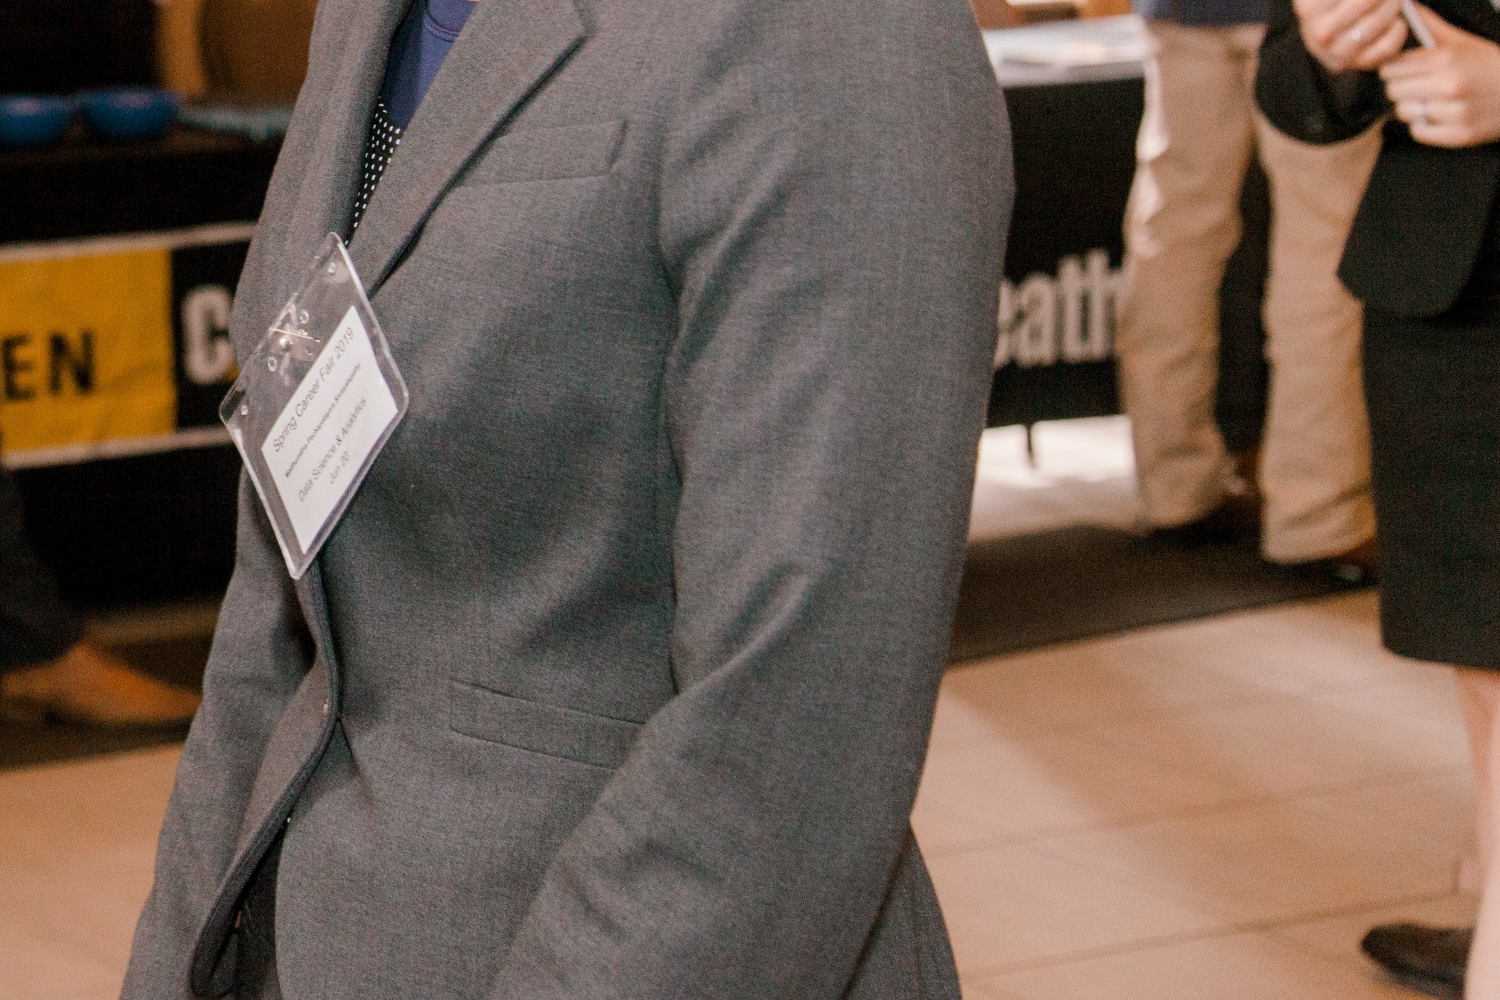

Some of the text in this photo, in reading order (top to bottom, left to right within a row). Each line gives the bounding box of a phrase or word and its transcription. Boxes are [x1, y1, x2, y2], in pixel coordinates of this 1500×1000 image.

[273, 416, 297, 453] Spring
[295, 379, 320, 417] Career
[319, 355, 335, 382] Fair
[335, 326, 354, 360] 2019
[298, 479, 314, 502] Data
[311, 445, 336, 480] Science
[341, 397, 366, 438] Analytics
[329, 465, 342, 484] Jun
